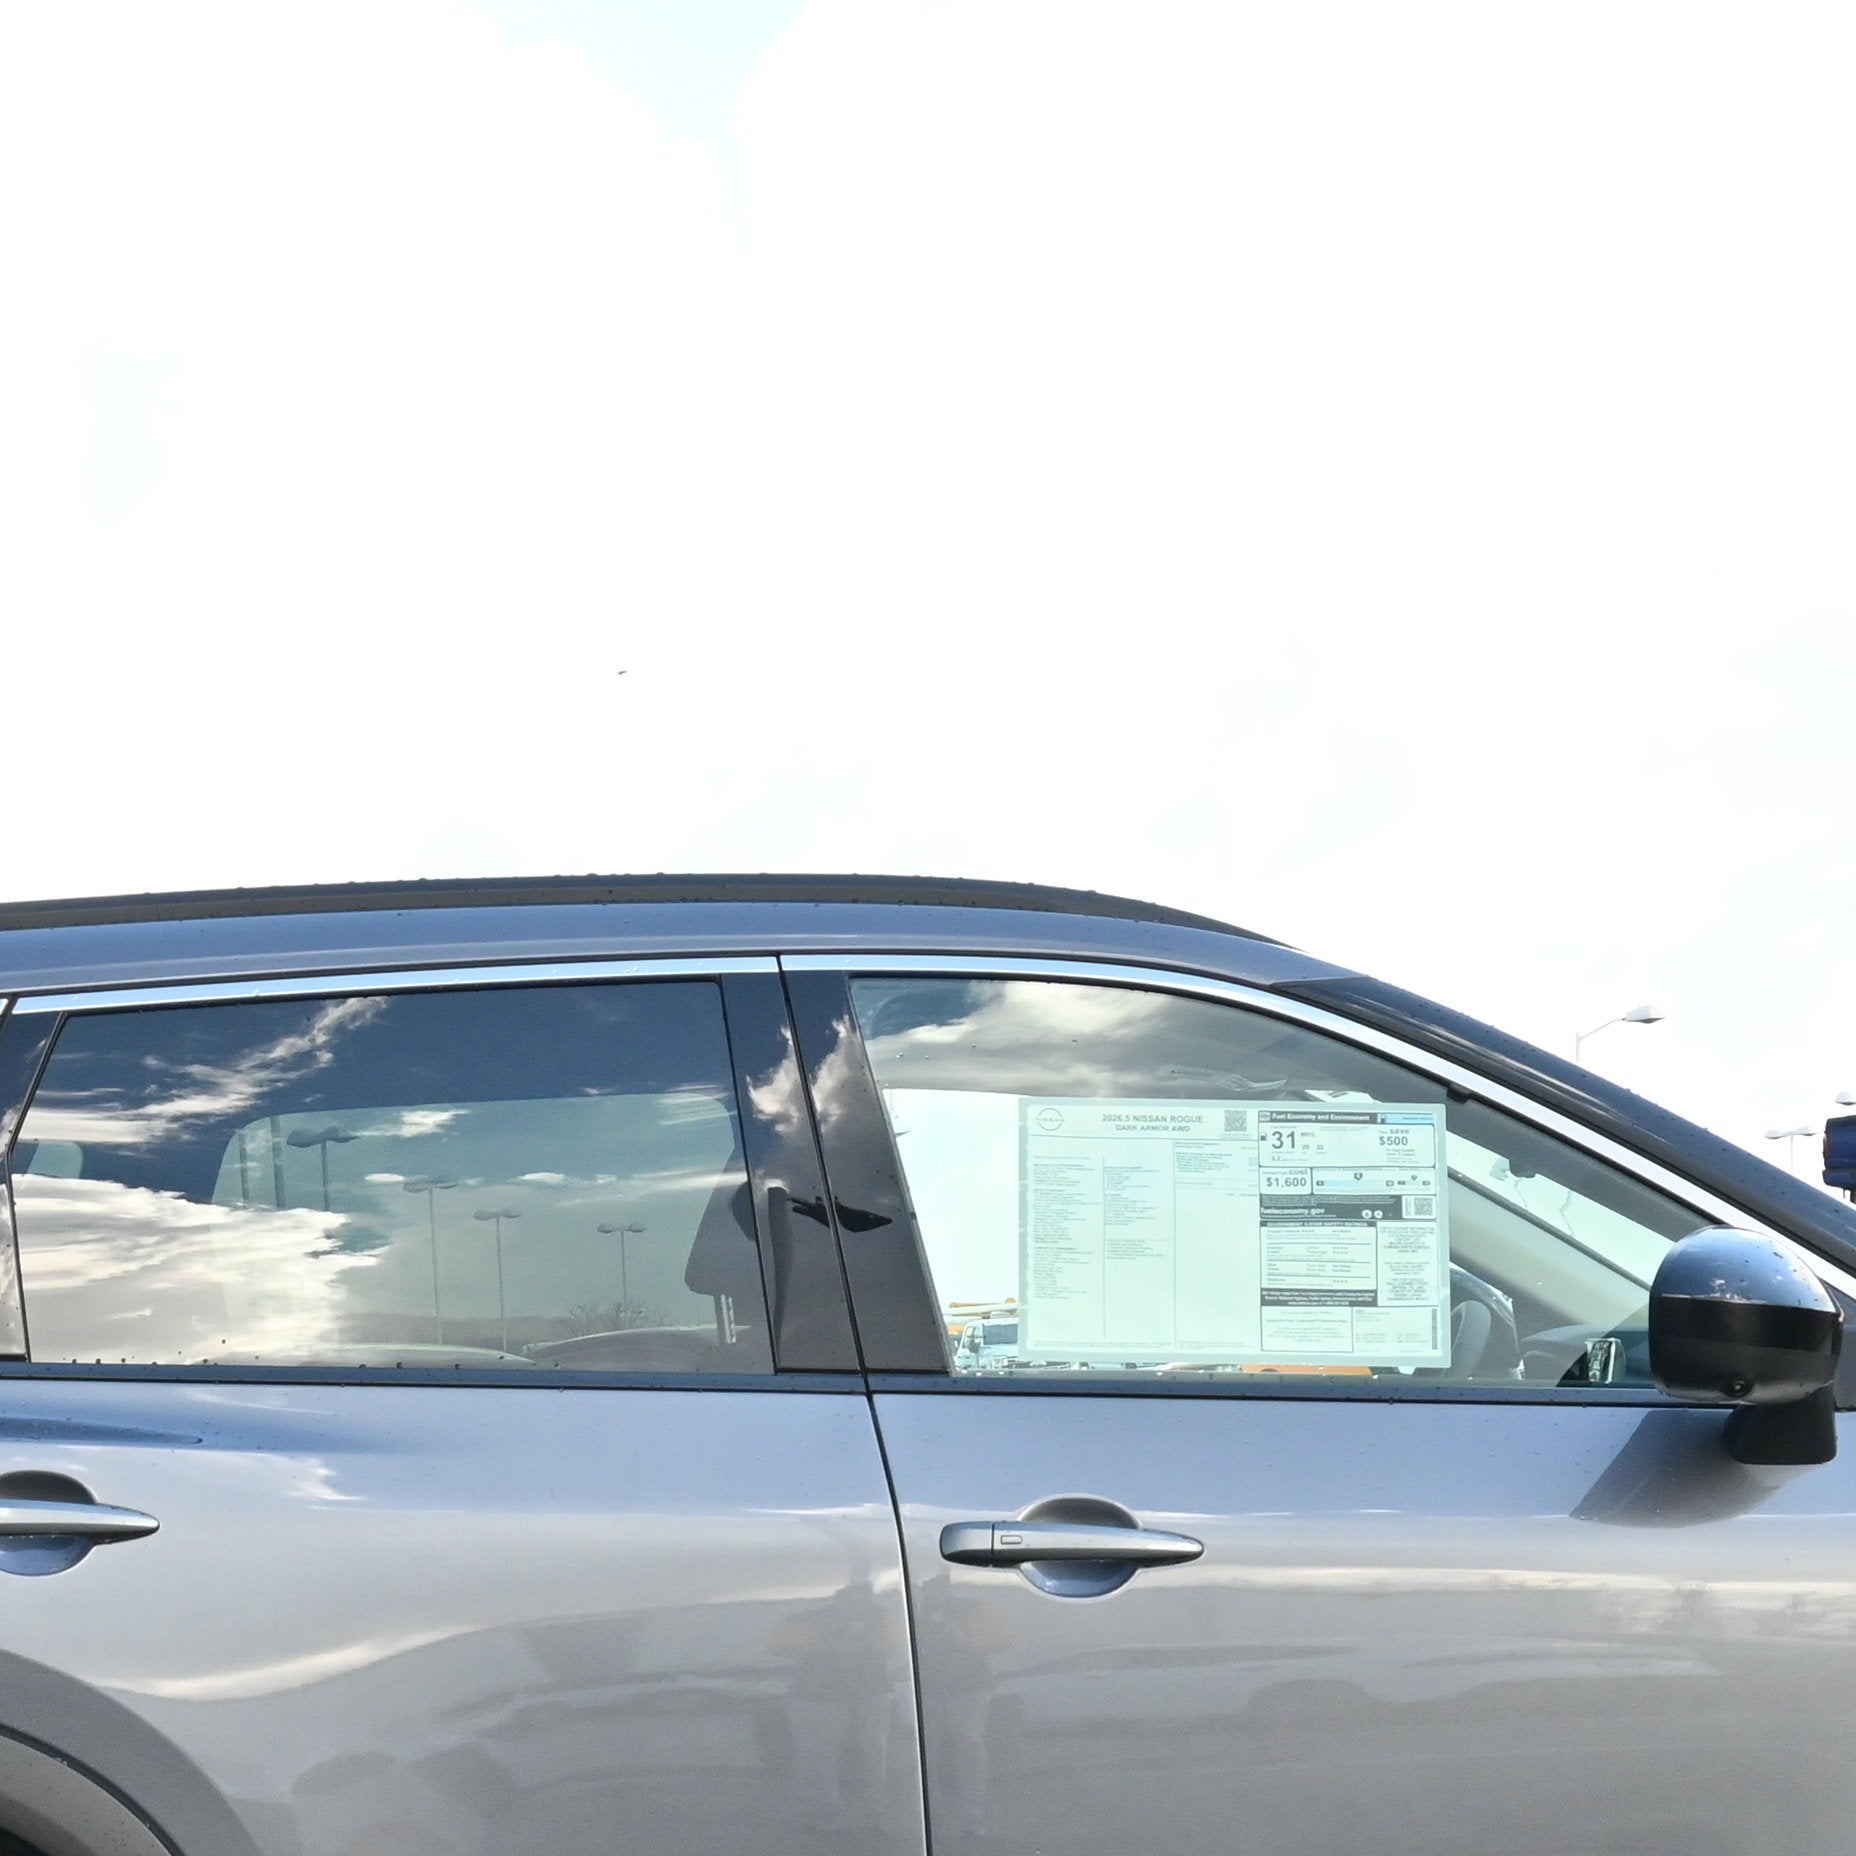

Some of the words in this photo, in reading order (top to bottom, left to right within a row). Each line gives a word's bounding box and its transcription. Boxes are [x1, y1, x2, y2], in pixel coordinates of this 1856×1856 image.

[1132, 1114, 1168, 1123] NISSAN
[1170, 1115, 1204, 1124] ROGUE
[1271, 1130, 1296, 1149] 31
[1378, 1135, 1409, 1146] $500
[1266, 1177, 1307, 1189] $1,600
